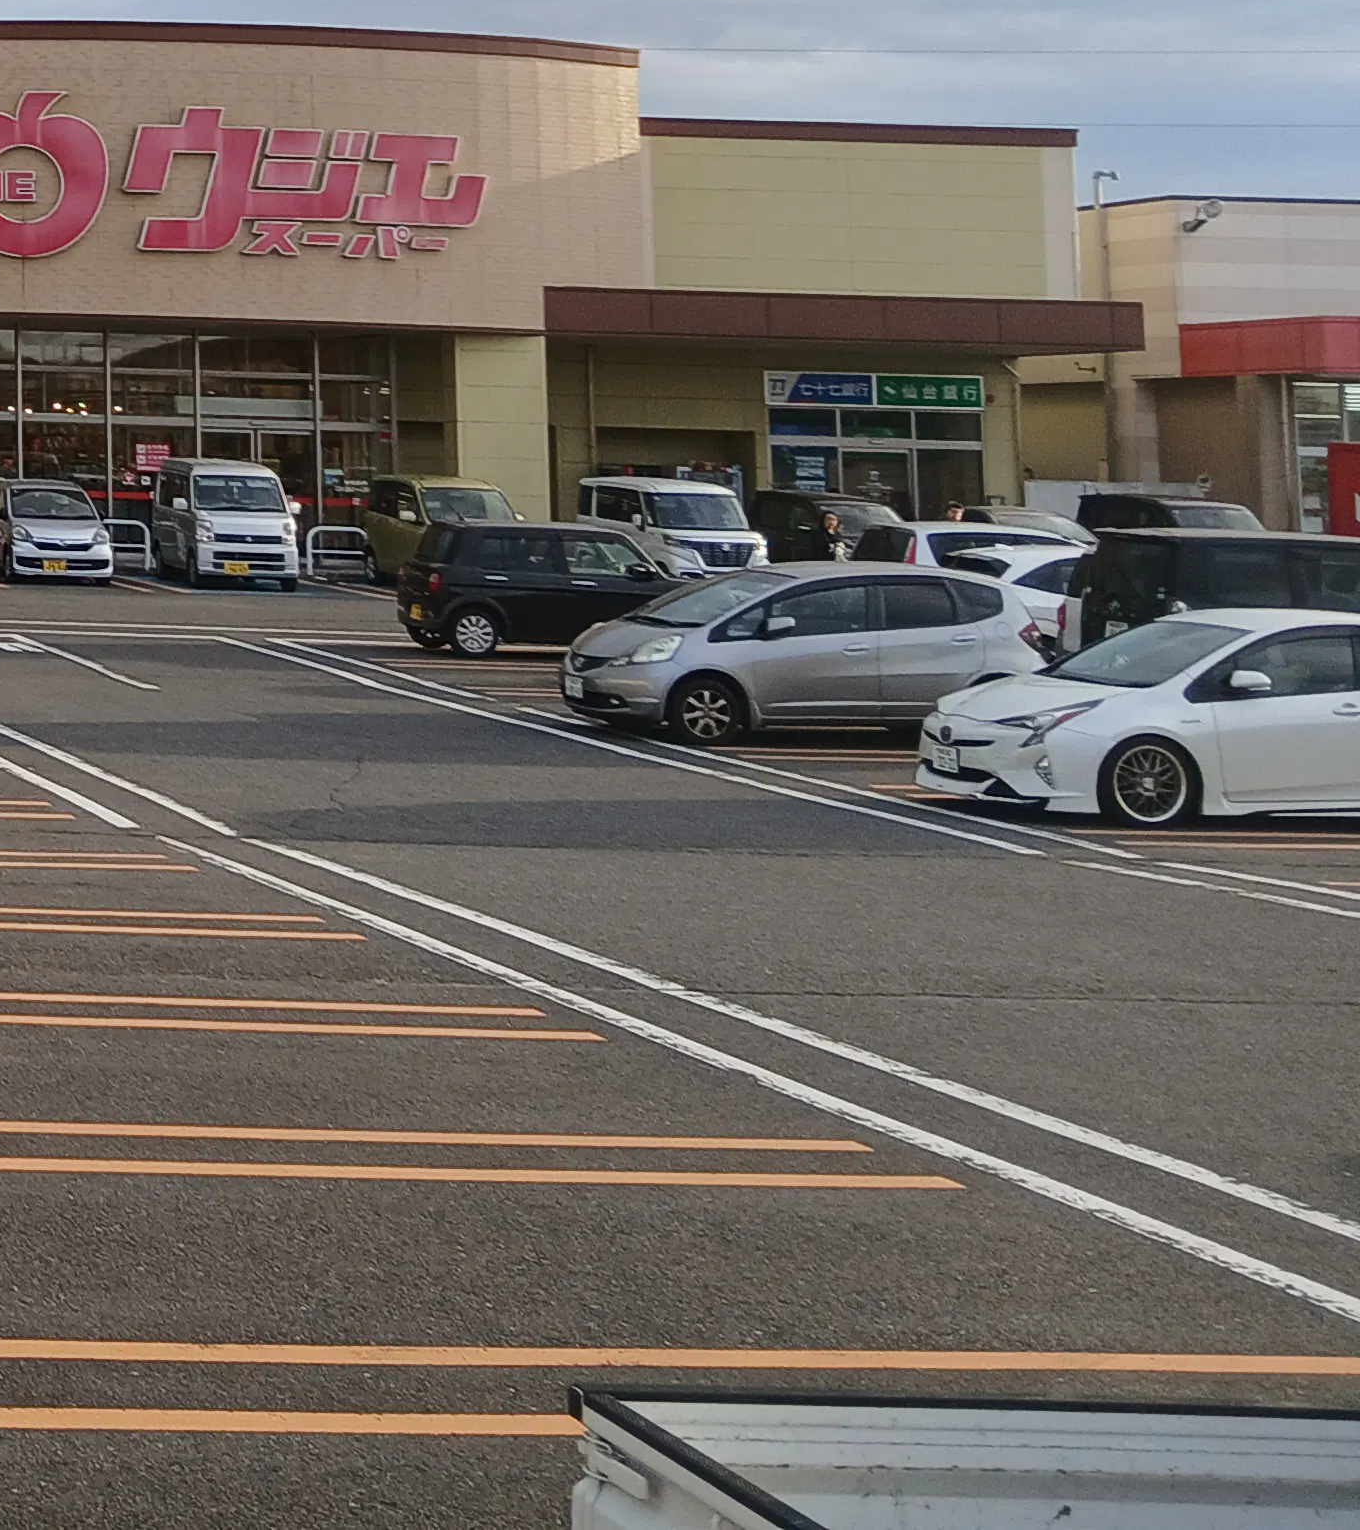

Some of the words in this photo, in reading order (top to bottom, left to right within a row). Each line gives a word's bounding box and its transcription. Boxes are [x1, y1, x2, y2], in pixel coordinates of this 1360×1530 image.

[122, 106, 489, 252] ウジエ
[240, 221, 449, 260] スーパー
[901, 383, 979, 402] 仙台銀行
